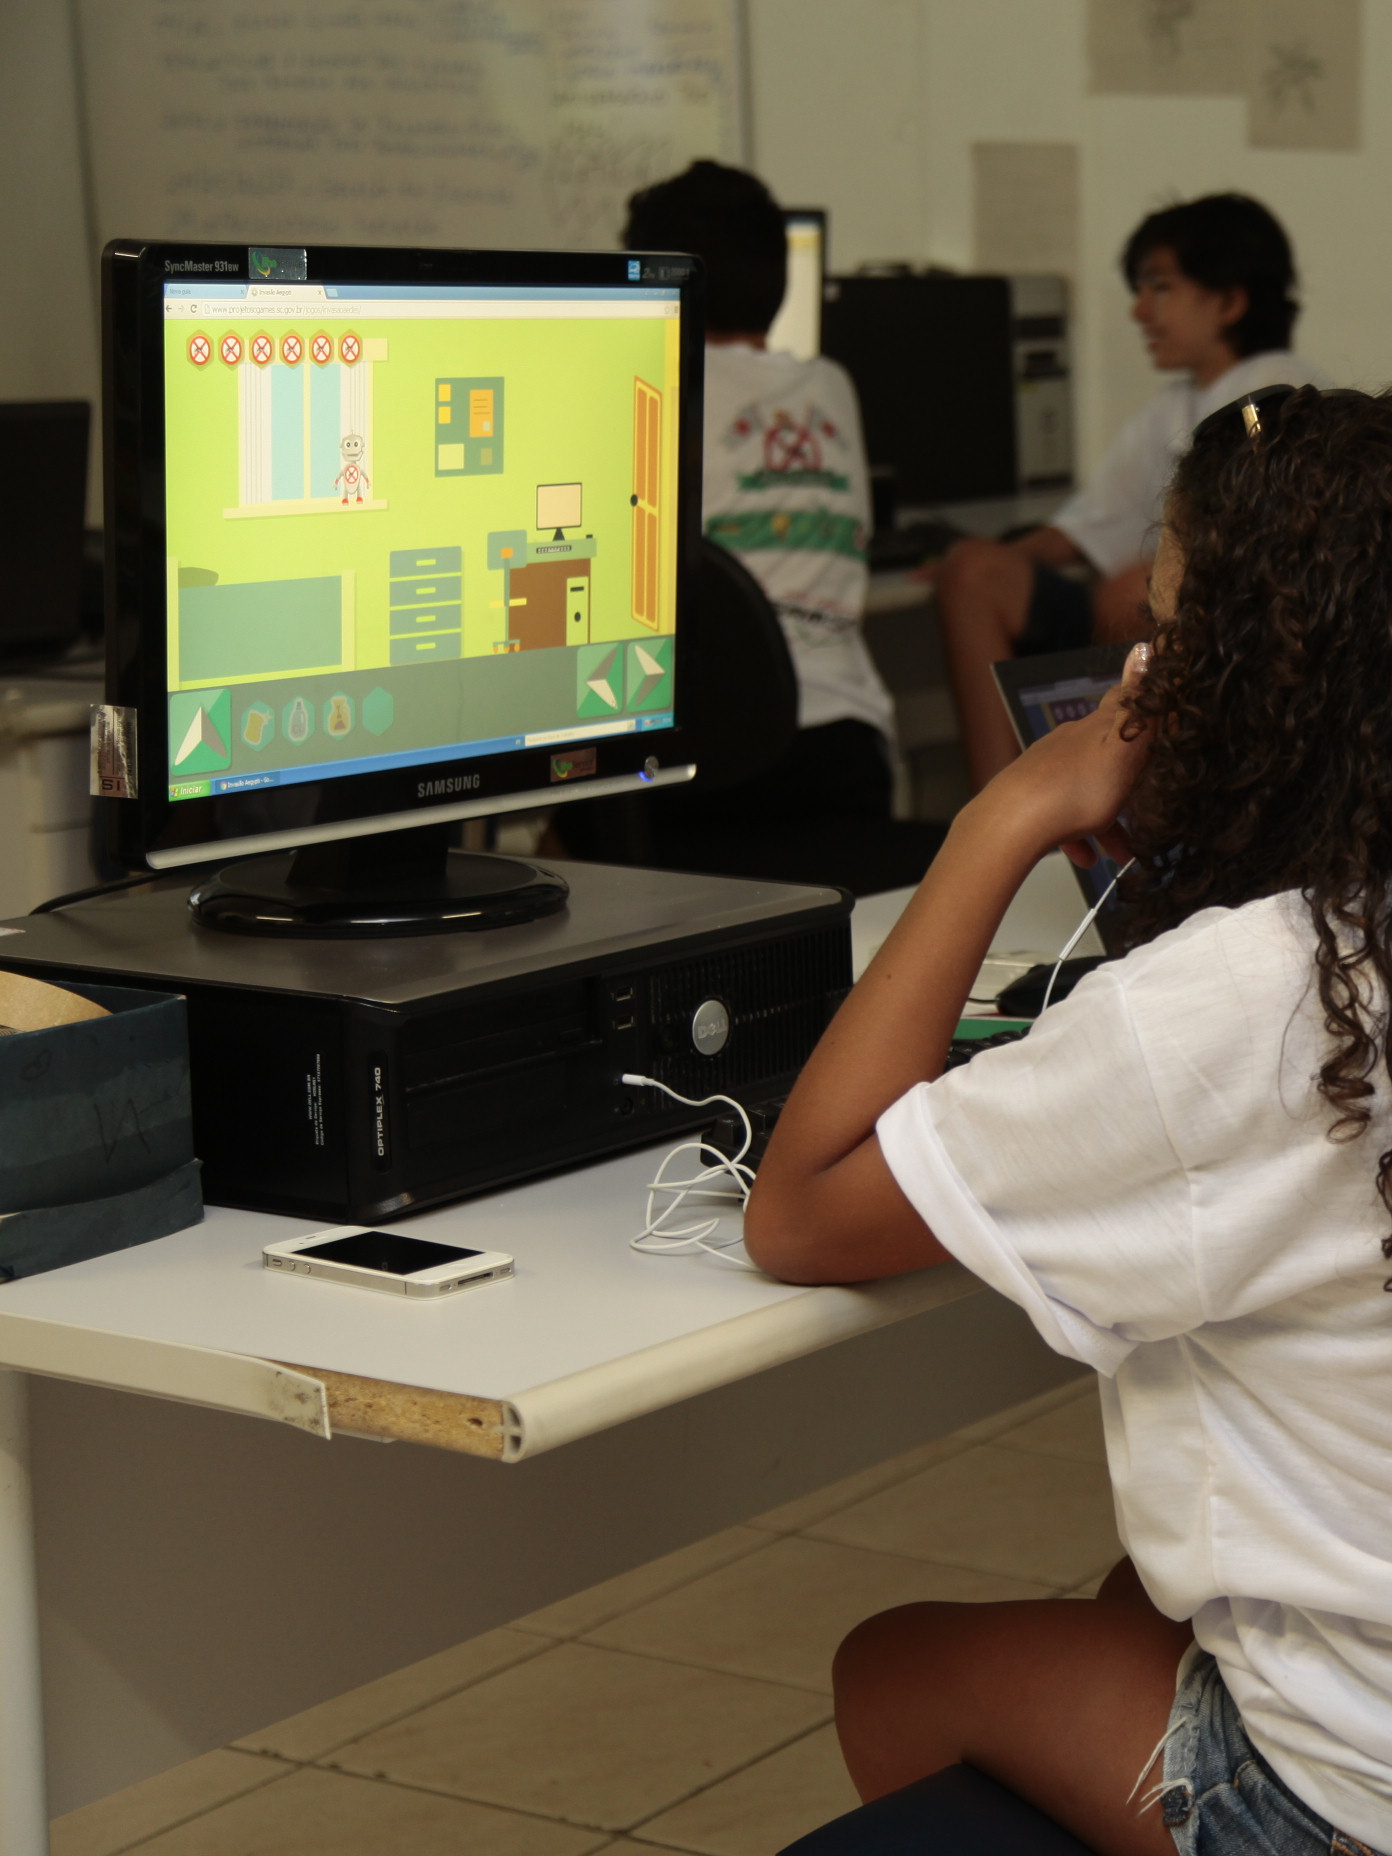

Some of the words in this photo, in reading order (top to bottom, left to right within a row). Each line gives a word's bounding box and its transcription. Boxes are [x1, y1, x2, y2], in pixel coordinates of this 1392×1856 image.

[164, 260, 213, 274] SyncMaster
[180, 786, 202, 796] Iniciar
[418, 775, 480, 798] SAMSUNG
[698, 1019, 728, 1039] DELL
[376, 1097, 384, 1156] OPTIPLEX
